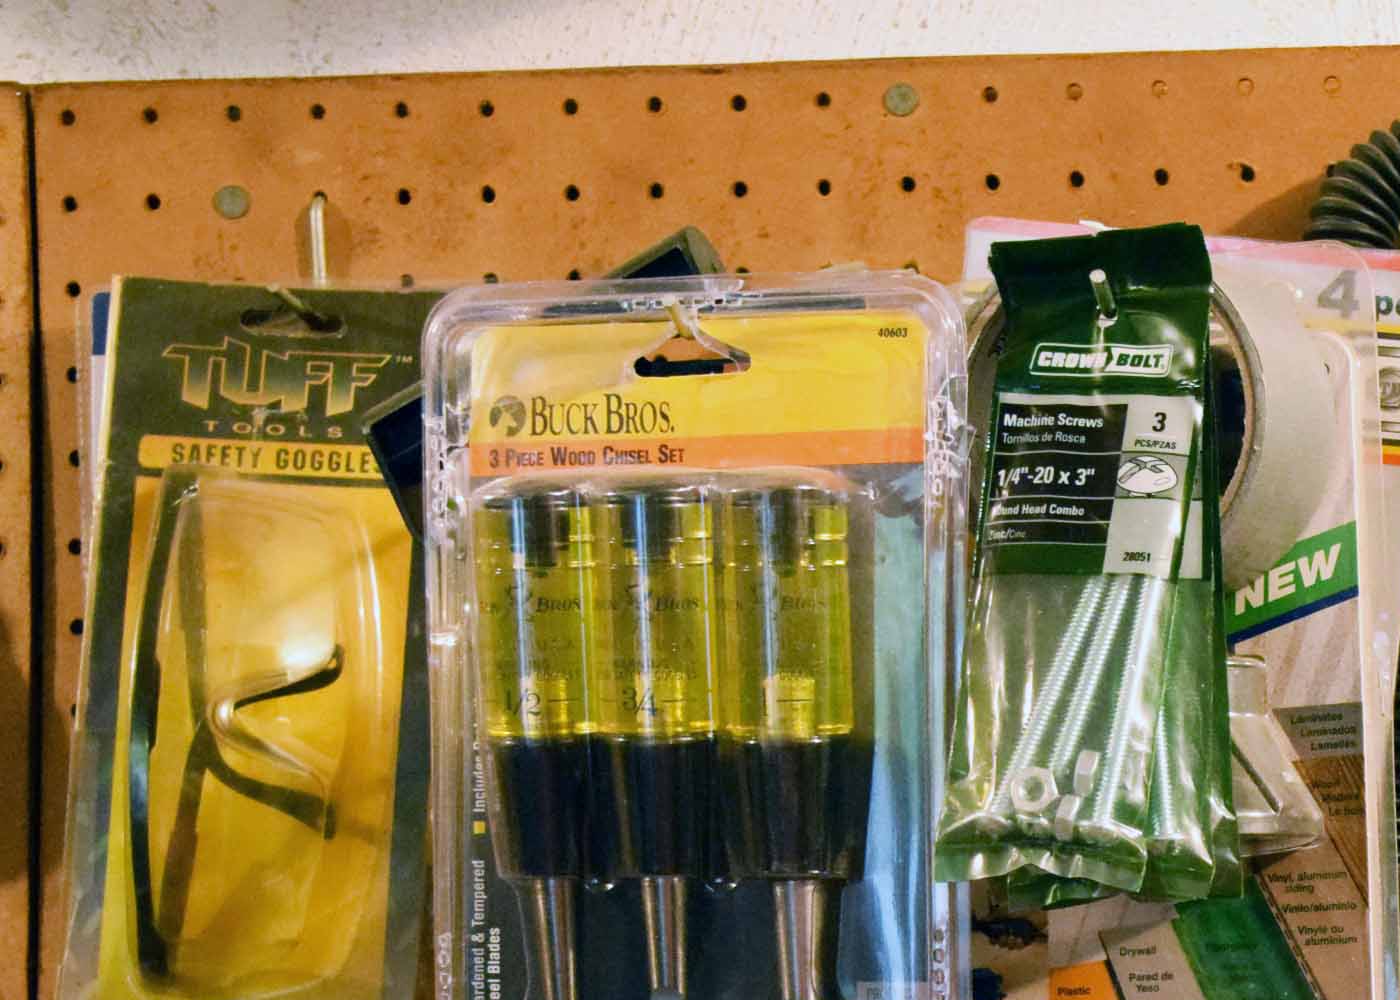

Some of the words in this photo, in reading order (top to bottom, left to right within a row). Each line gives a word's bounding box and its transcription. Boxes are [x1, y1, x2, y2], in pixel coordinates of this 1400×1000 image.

[1317, 270, 1360, 319] 4
[877, 327, 908, 339] 40603
[1116, 353, 1164, 368] BOLT
[161, 336, 392, 417] TUFF
[530, 396, 600, 436] BUCK
[603, 393, 675, 434] BROS.
[1003, 413, 1055, 428] Machine
[1057, 413, 1104, 428] Screws
[1152, 412, 1167, 432] 3
[203, 419, 344, 438] TOOLS
[1002, 432, 1040, 444] Tornillos
[1041, 432, 1053, 442] de
[1055, 432, 1086, 444] Rosca
[172, 443, 261, 468] SAFETY
[275, 447, 381, 473] GOGGLE
[489, 449, 499, 467] 3
[505, 448, 544, 467] PIECE
[551, 446, 595, 465] WOOD
[602, 445, 652, 464] CHISEL
[658, 444, 685, 463] SET
[997, 466, 1055, 487] 1/4"-20
[1058, 471, 1070, 485] x
[1074, 467, 1095, 486] 3"
[1021, 503, 1046, 514] Head
[1049, 503, 1085, 516] Combo
[1235, 542, 1342, 616] NEW
[472, 860, 486, 928] Tempered
[472, 933, 485, 943] &
[488, 927, 500, 973] Blades
[1161, 971, 1173, 981] de
